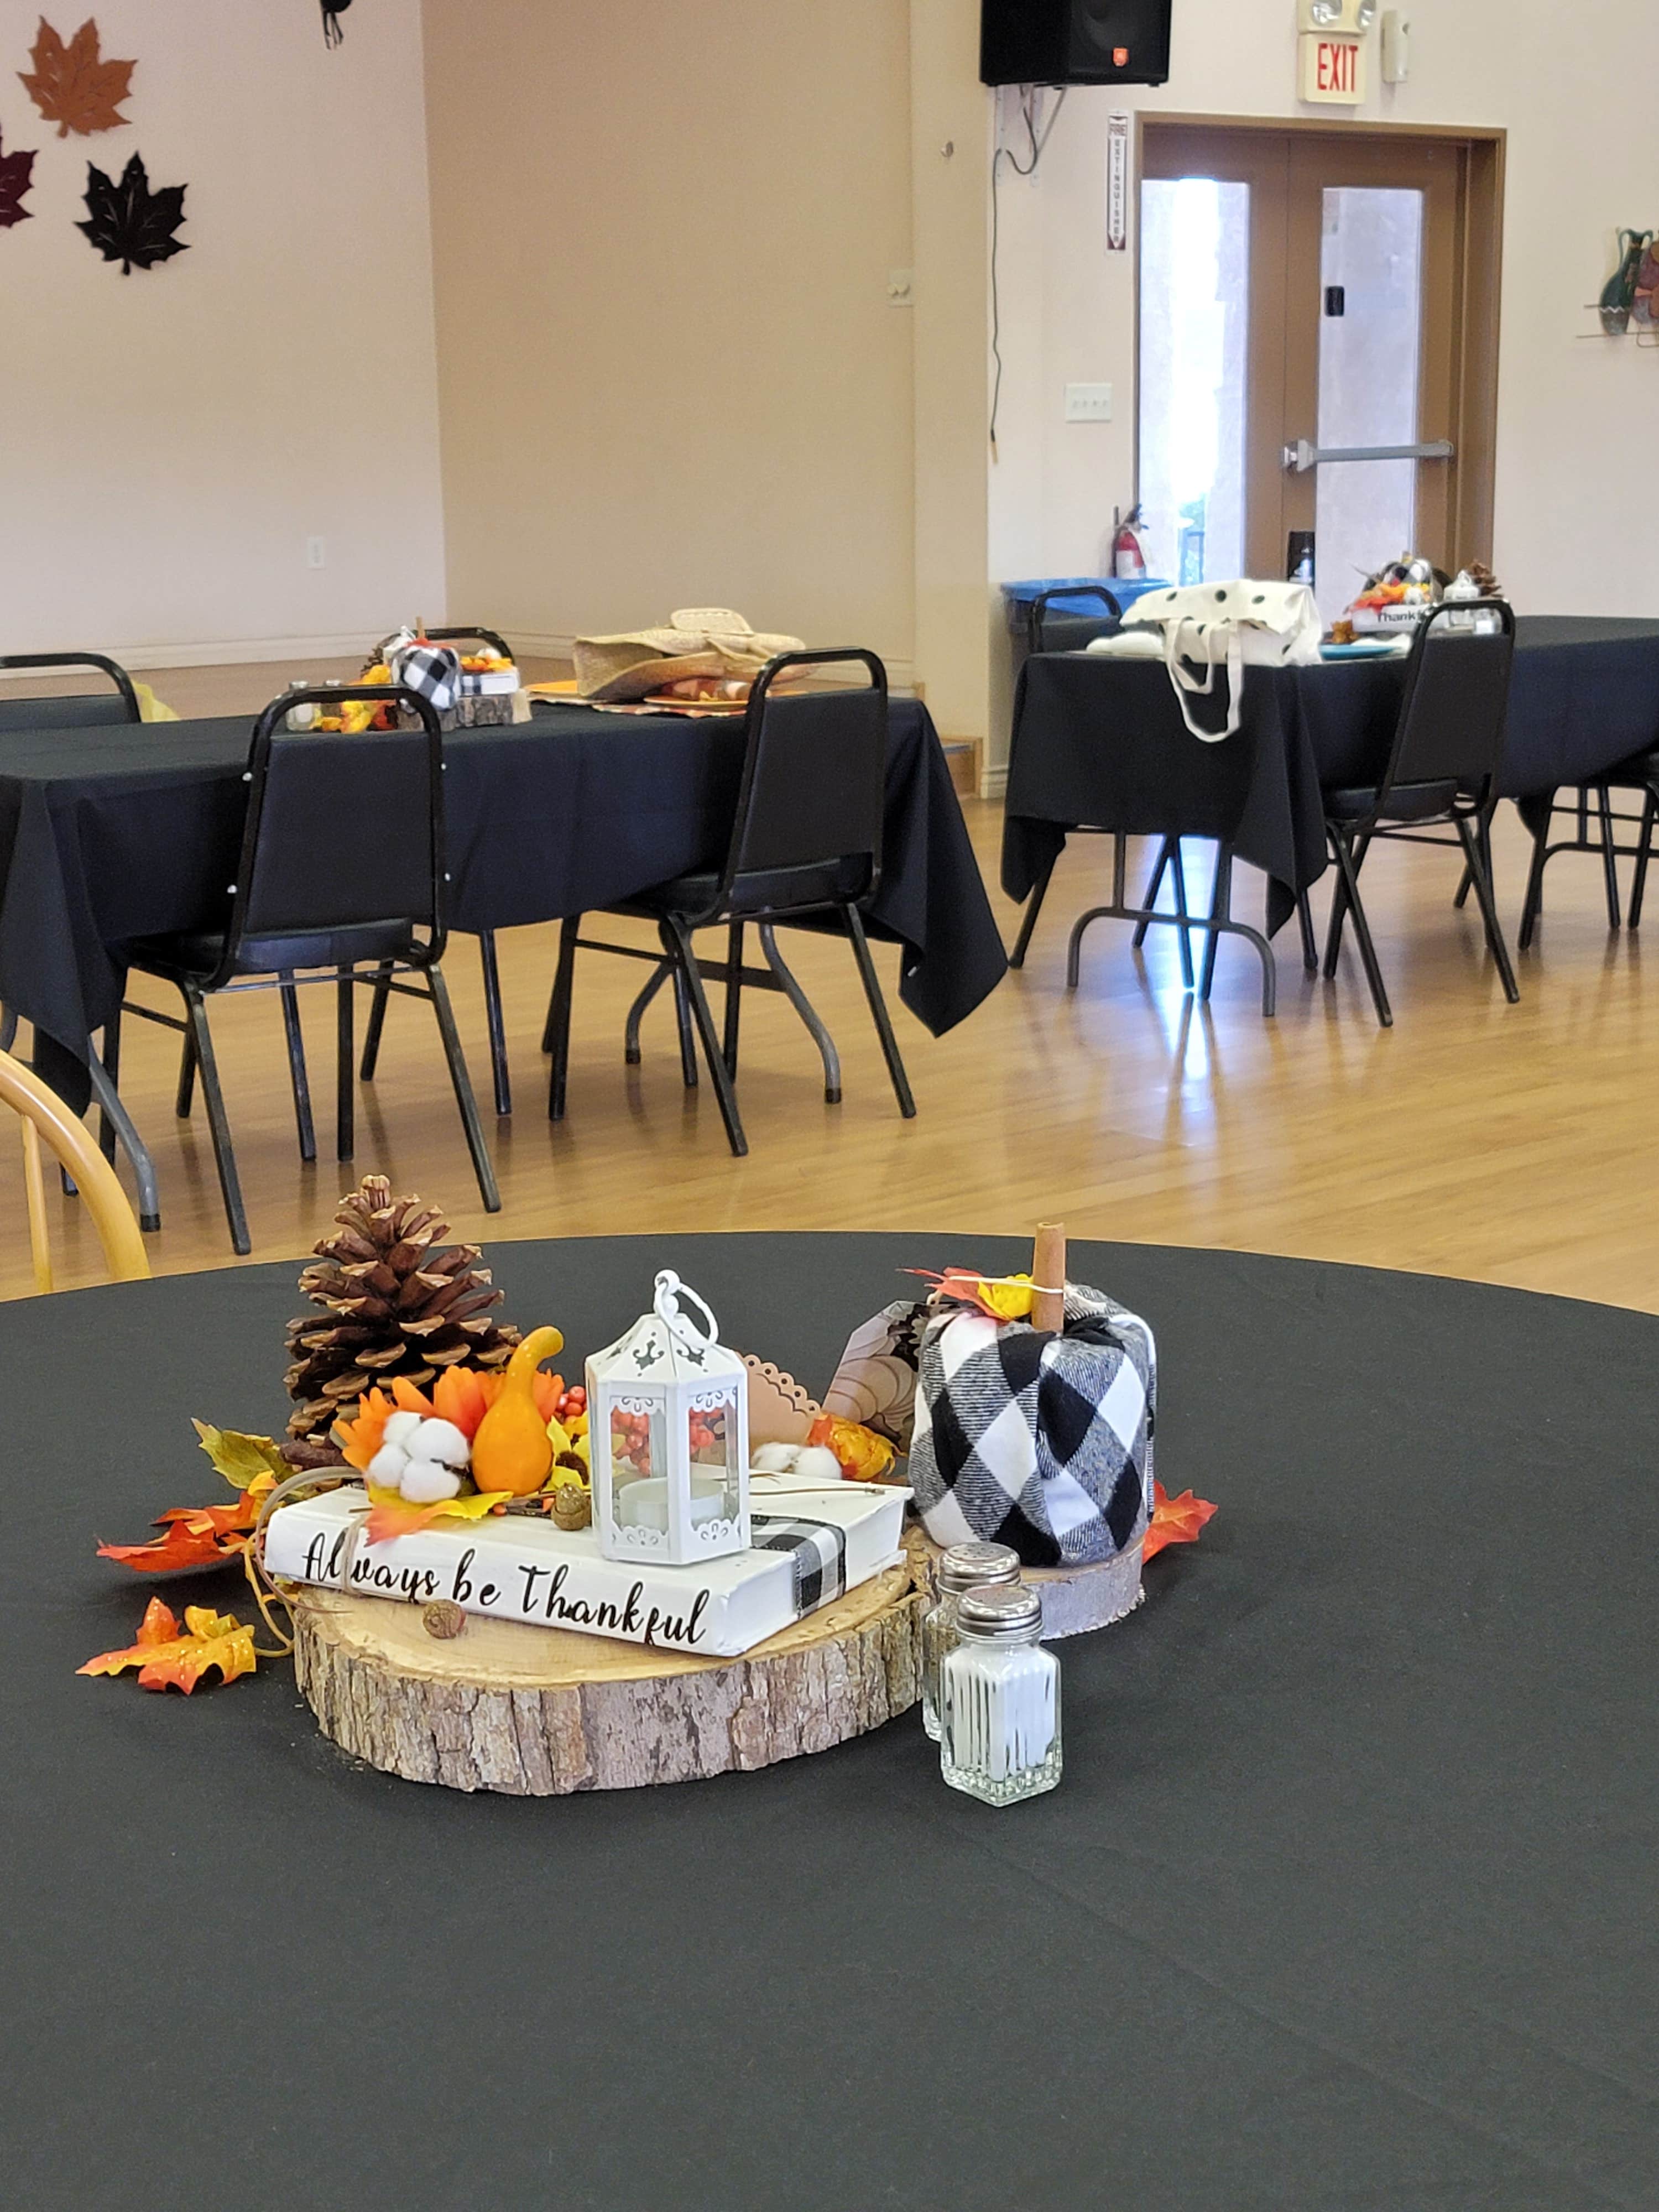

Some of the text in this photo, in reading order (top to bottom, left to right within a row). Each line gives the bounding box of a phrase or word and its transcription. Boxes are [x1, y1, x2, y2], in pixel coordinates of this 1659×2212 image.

[1317, 42, 1359, 92] EXIT
[452, 1548, 501, 1605] be
[518, 1563, 709, 1646] Thankful
